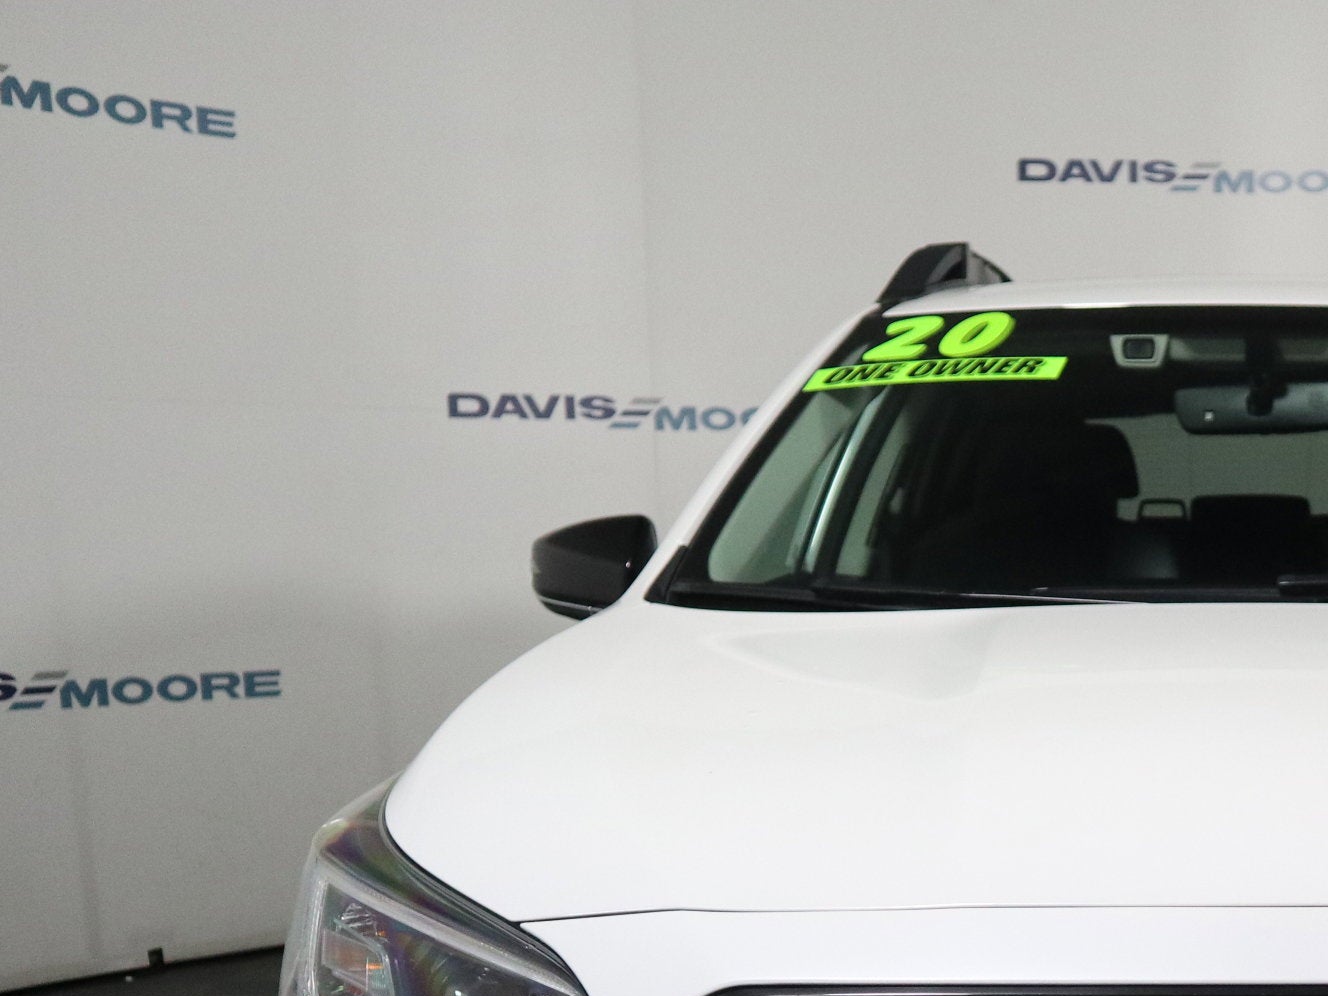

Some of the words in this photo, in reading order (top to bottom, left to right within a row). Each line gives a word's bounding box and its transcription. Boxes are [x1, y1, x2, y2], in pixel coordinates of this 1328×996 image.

[0, 75, 236, 138] MOORE
[1017, 158, 1177, 182] DAVIS
[862, 311, 1016, 362] 20
[823, 361, 902, 385] ONE
[909, 357, 1045, 379] OWNER
[447, 393, 617, 420] DAVIS
[59, 669, 281, 709] MOORE
